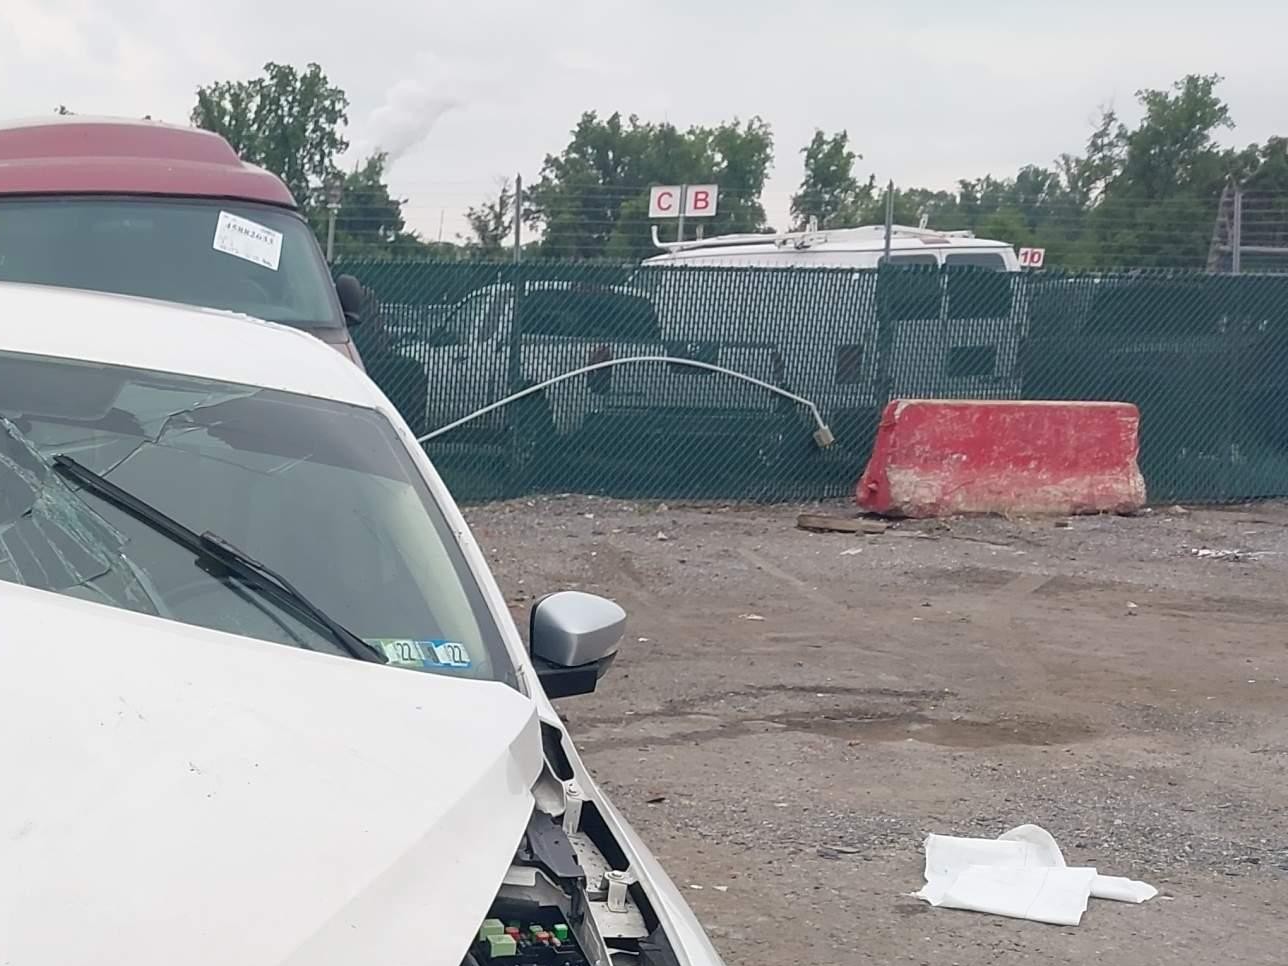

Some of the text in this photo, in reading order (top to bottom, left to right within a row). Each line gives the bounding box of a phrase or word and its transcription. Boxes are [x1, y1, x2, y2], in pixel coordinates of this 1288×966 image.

[657, 190, 710, 211] C B
[1020, 250, 1042, 265] 10
[396, 642, 417, 662] 22
[447, 644, 469, 664] 22
